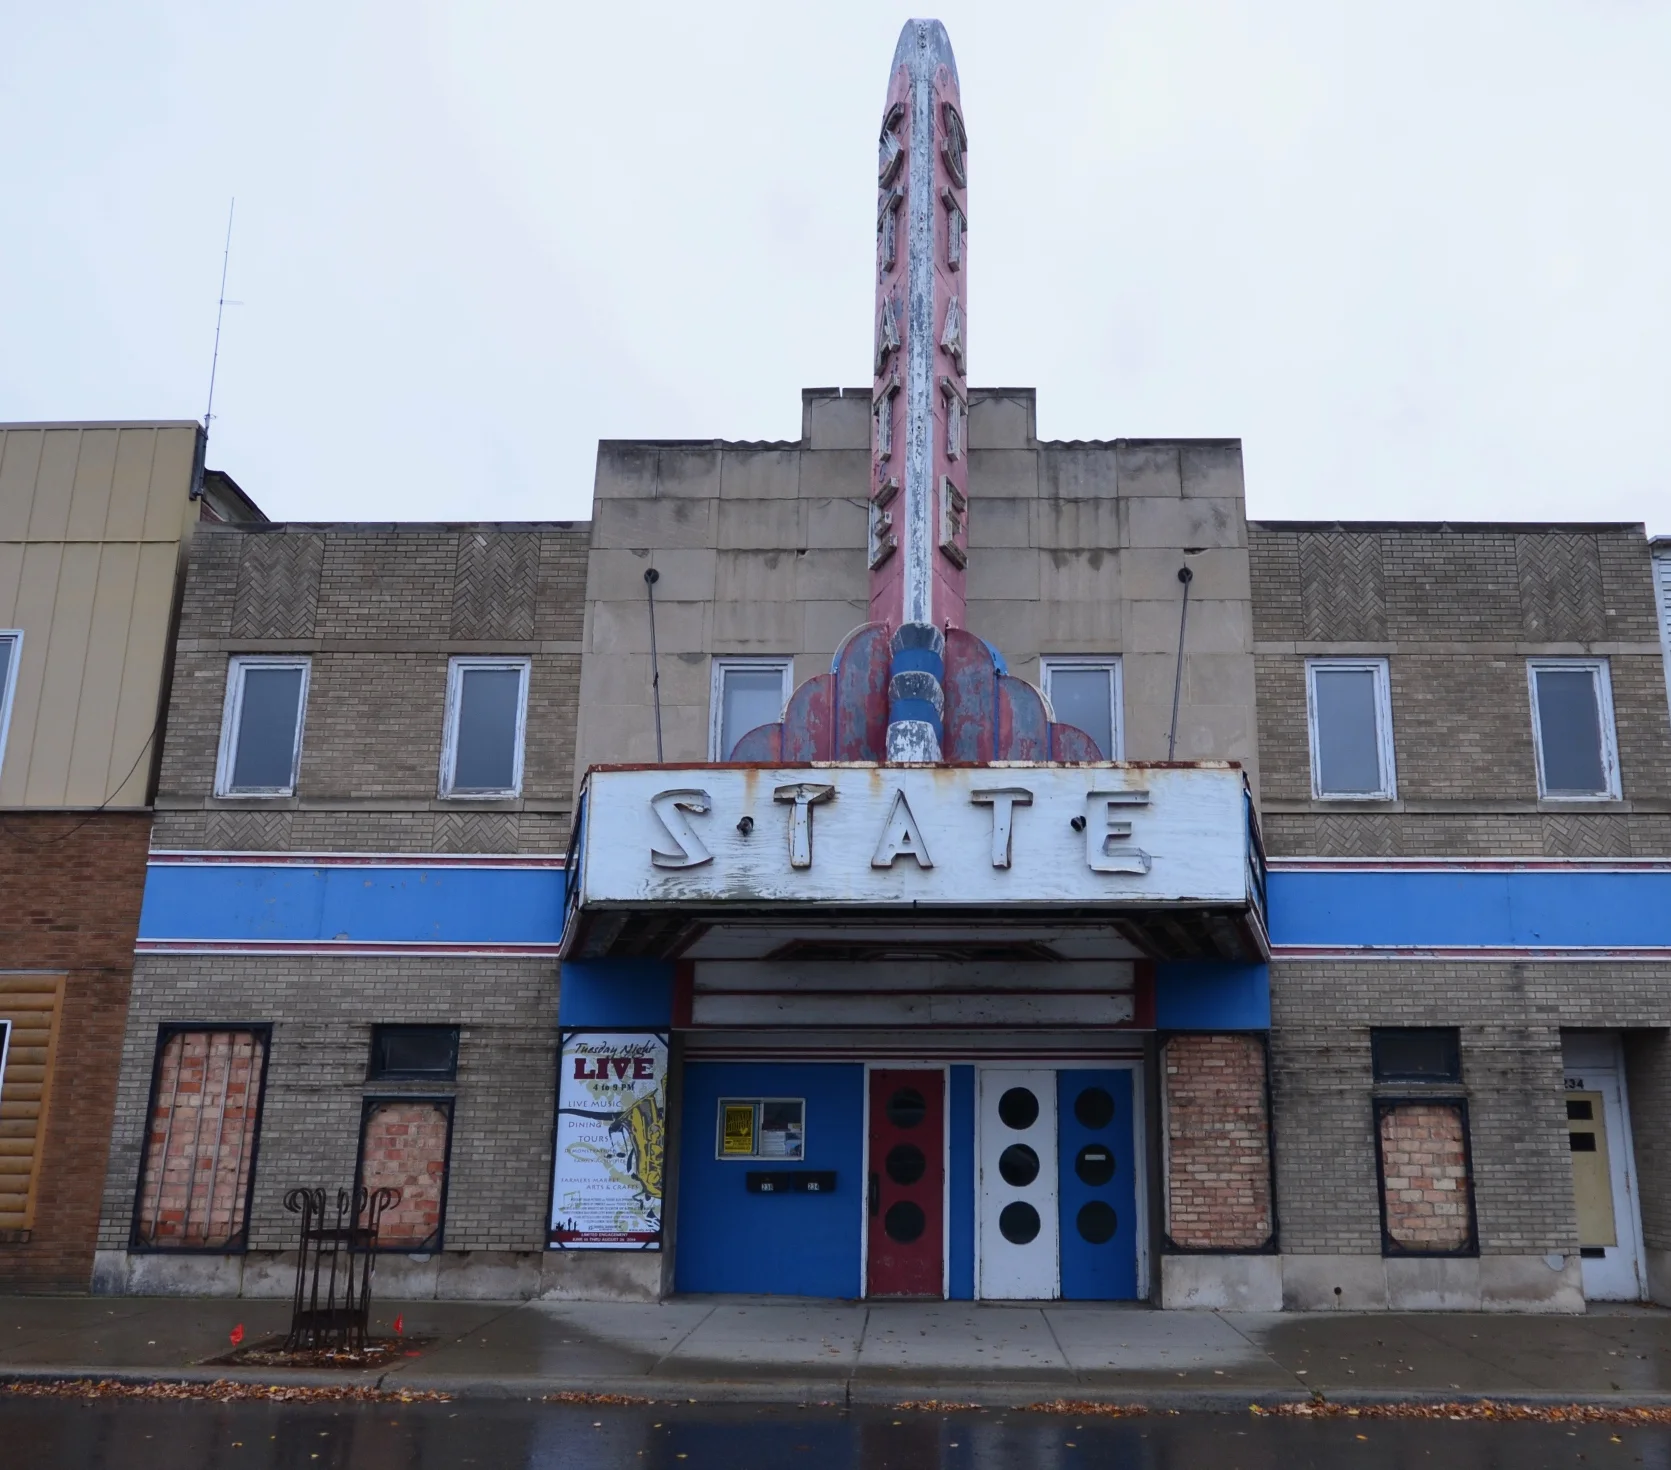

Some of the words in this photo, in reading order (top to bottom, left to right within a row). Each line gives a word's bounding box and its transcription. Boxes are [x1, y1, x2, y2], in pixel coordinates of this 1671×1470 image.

[650, 783, 1152, 873] STATE
[575, 1041, 618, 1059] Tuesday
[619, 1040, 657, 1059] Night
[574, 1058, 654, 1080] LIVE
[621, 1083, 635, 1091] PM
